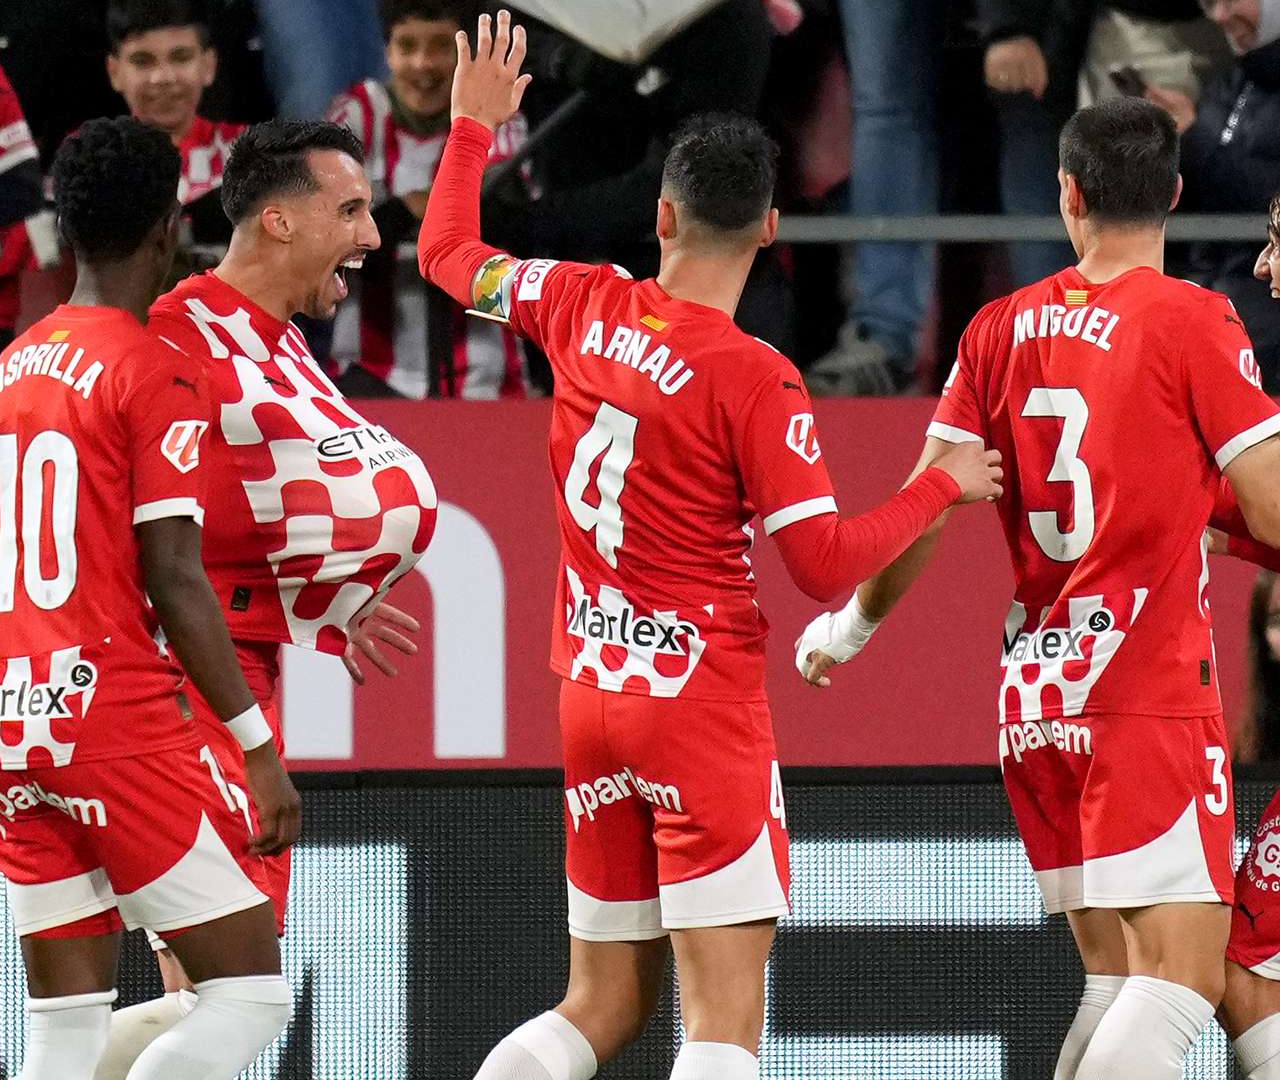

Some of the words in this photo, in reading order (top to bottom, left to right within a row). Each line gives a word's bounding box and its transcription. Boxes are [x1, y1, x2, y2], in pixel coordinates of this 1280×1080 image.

[580, 320, 695, 396] ARNAU
[1012, 304, 1120, 352] MIGUEL
[368, 448, 414, 470] AIRW
[564, 400, 640, 570] 4
[1021, 387, 1096, 563] 3
[581, 766, 683, 822] parlem
[769, 759, 787, 829] 4
[1204, 745, 1228, 816] 3
[1255, 878, 1269, 891] de
